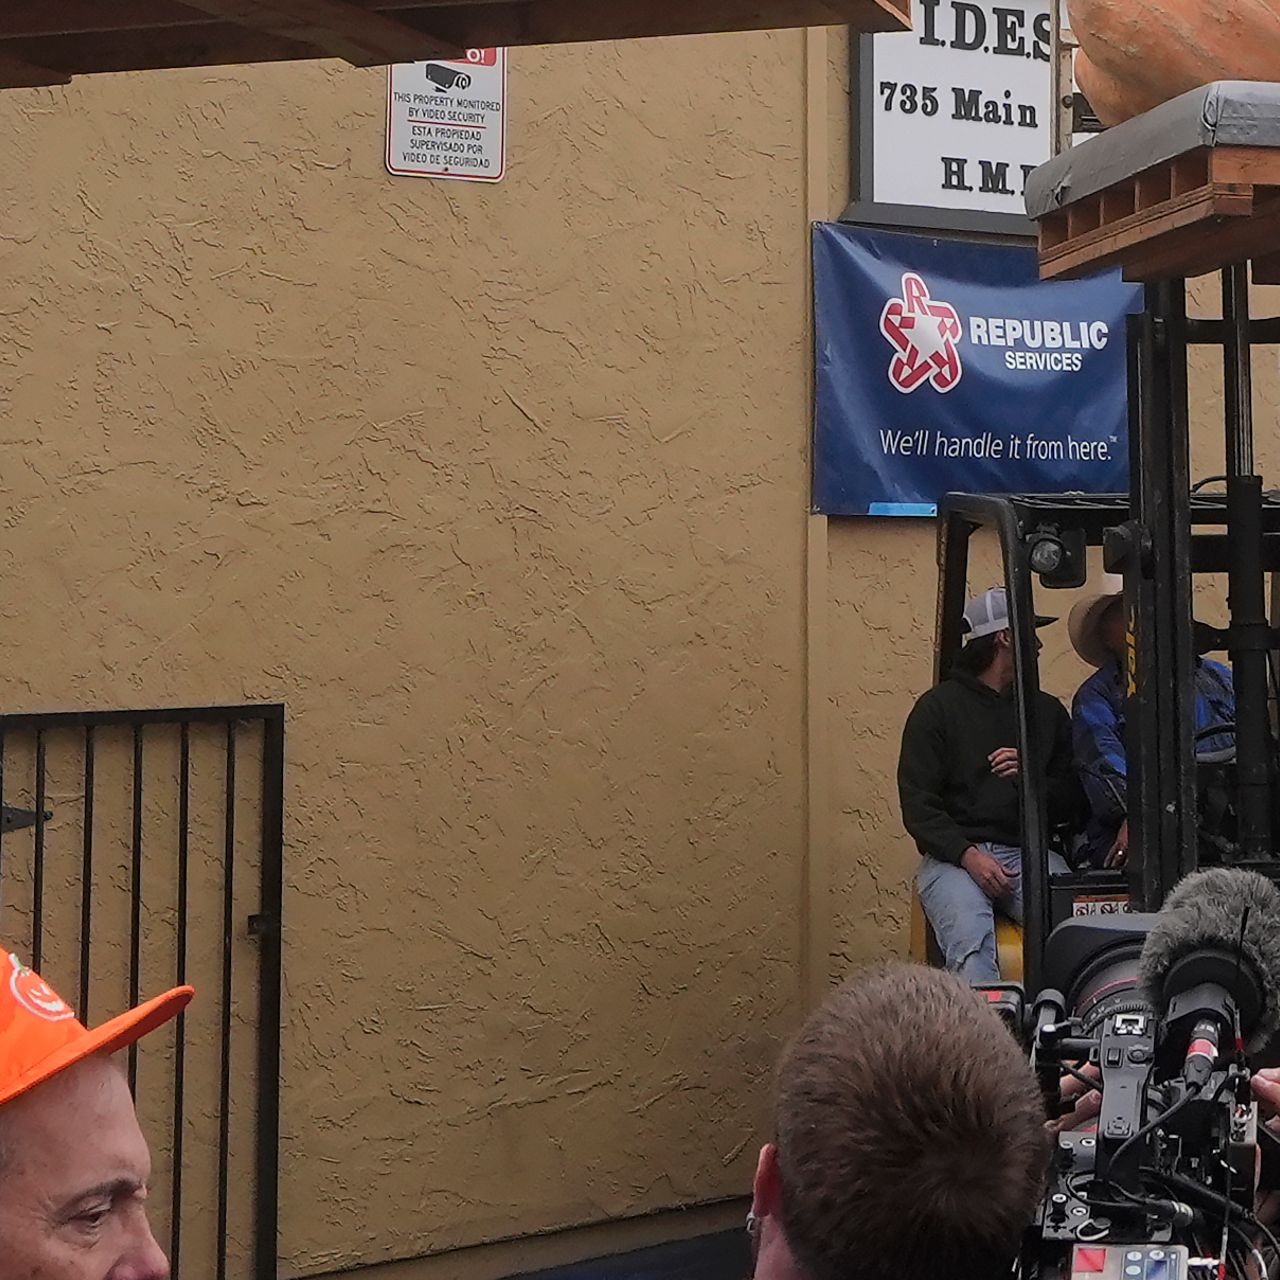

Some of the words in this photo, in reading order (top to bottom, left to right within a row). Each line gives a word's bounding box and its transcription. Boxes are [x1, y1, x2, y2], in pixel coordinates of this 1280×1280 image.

[394, 91, 412, 104] THIS
[413, 94, 455, 108] PROPERTY
[456, 98, 501, 112] MONITORED
[880, 81, 940, 116] 735
[952, 87, 1039, 128] Main
[408, 107, 420, 118] BY
[421, 109, 446, 120] VIDEO
[447, 111, 486, 124] SECURITY
[412, 126, 433, 137] ESTA
[435, 128, 482, 141] PROPIEDAD
[410, 139, 465, 153] SUPERVISADO
[467, 144, 483, 155] POR
[402, 152, 428, 164] VIDEO
[429, 153, 441, 165] DE
[443, 155, 491, 169] SEGURIDAD
[970, 317, 1109, 350] REPUBLIC
[1005, 351, 1082, 372] SERVICES
[880, 429, 928, 456] We'll
[935, 431, 1003, 458] handle
[1009, 434, 1020, 458] it
[1025, 434, 1064, 460] from
